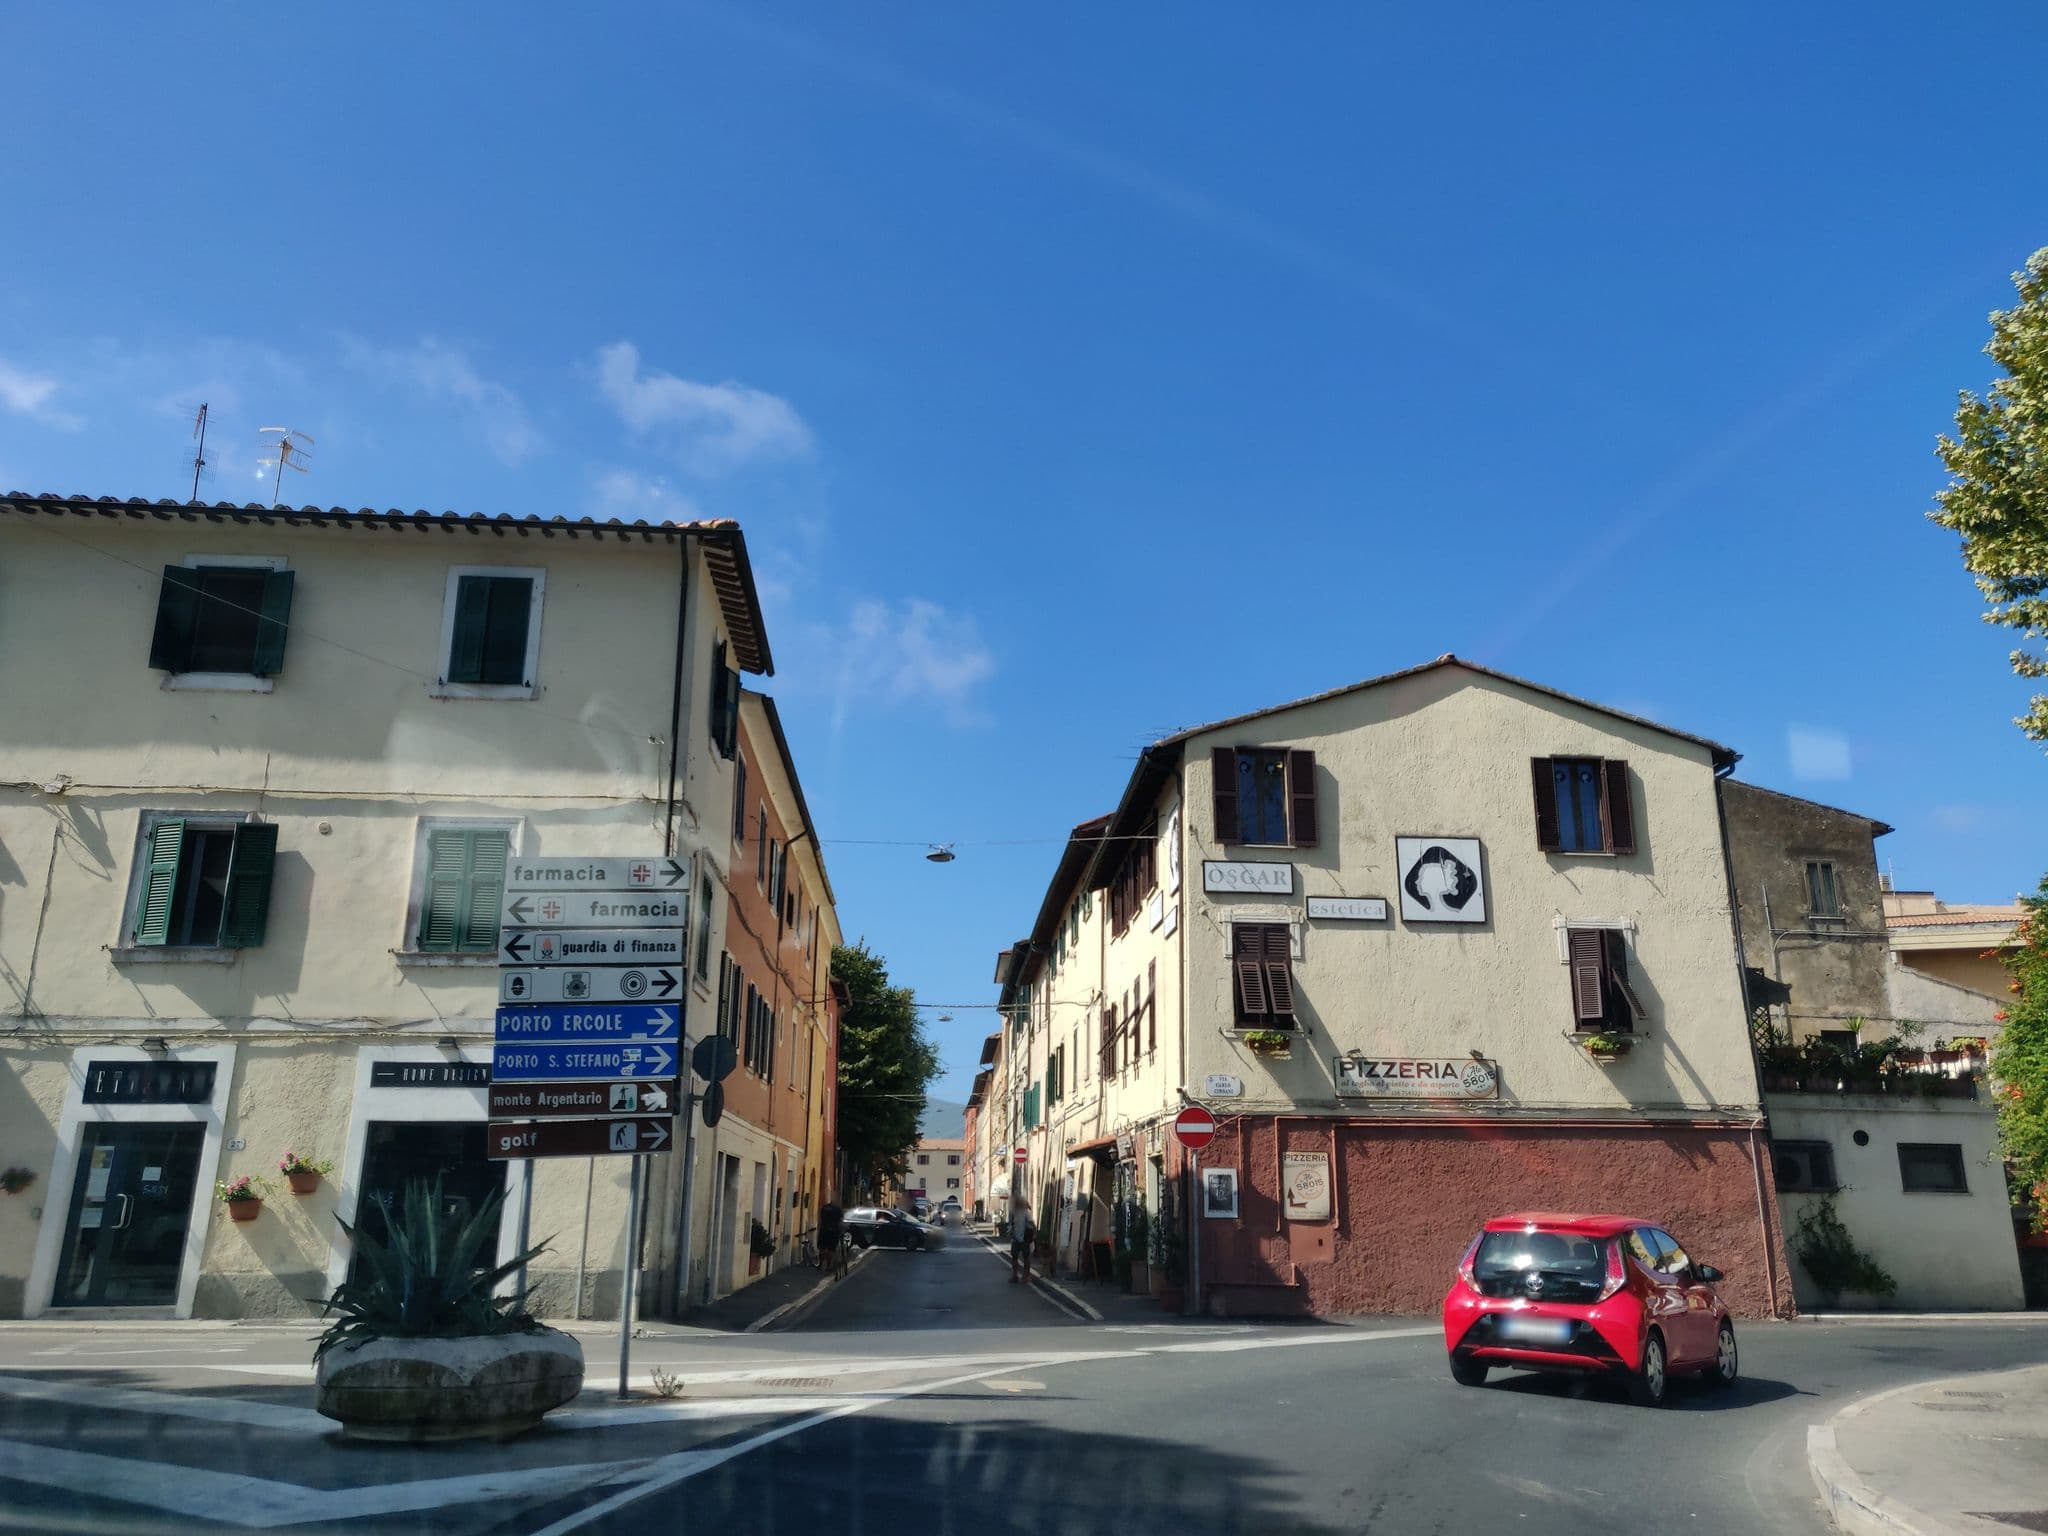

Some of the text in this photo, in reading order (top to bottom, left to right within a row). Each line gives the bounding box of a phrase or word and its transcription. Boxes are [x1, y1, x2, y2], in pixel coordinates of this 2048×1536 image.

[514, 865, 606, 881] farmacia
[1208, 868, 1287, 886] OSCAR
[590, 901, 679, 918] farmacia
[1310, 902, 1383, 915] estetica
[562, 939, 677, 956] guardia di finanza
[500, 1014, 622, 1032] PORTO ERCOLE
[498, 1054, 539, 1069] PORTO
[549, 1054, 560, 1068] S.
[566, 1053, 620, 1068] STEFANO
[1339, 1061, 1459, 1079] PIZZERIA
[1463, 1070, 1496, 1088] 58015
[493, 1091, 603, 1107] monte Argentario
[500, 1132, 537, 1150] golf
[1284, 1154, 1328, 1162] PIZZERIA
